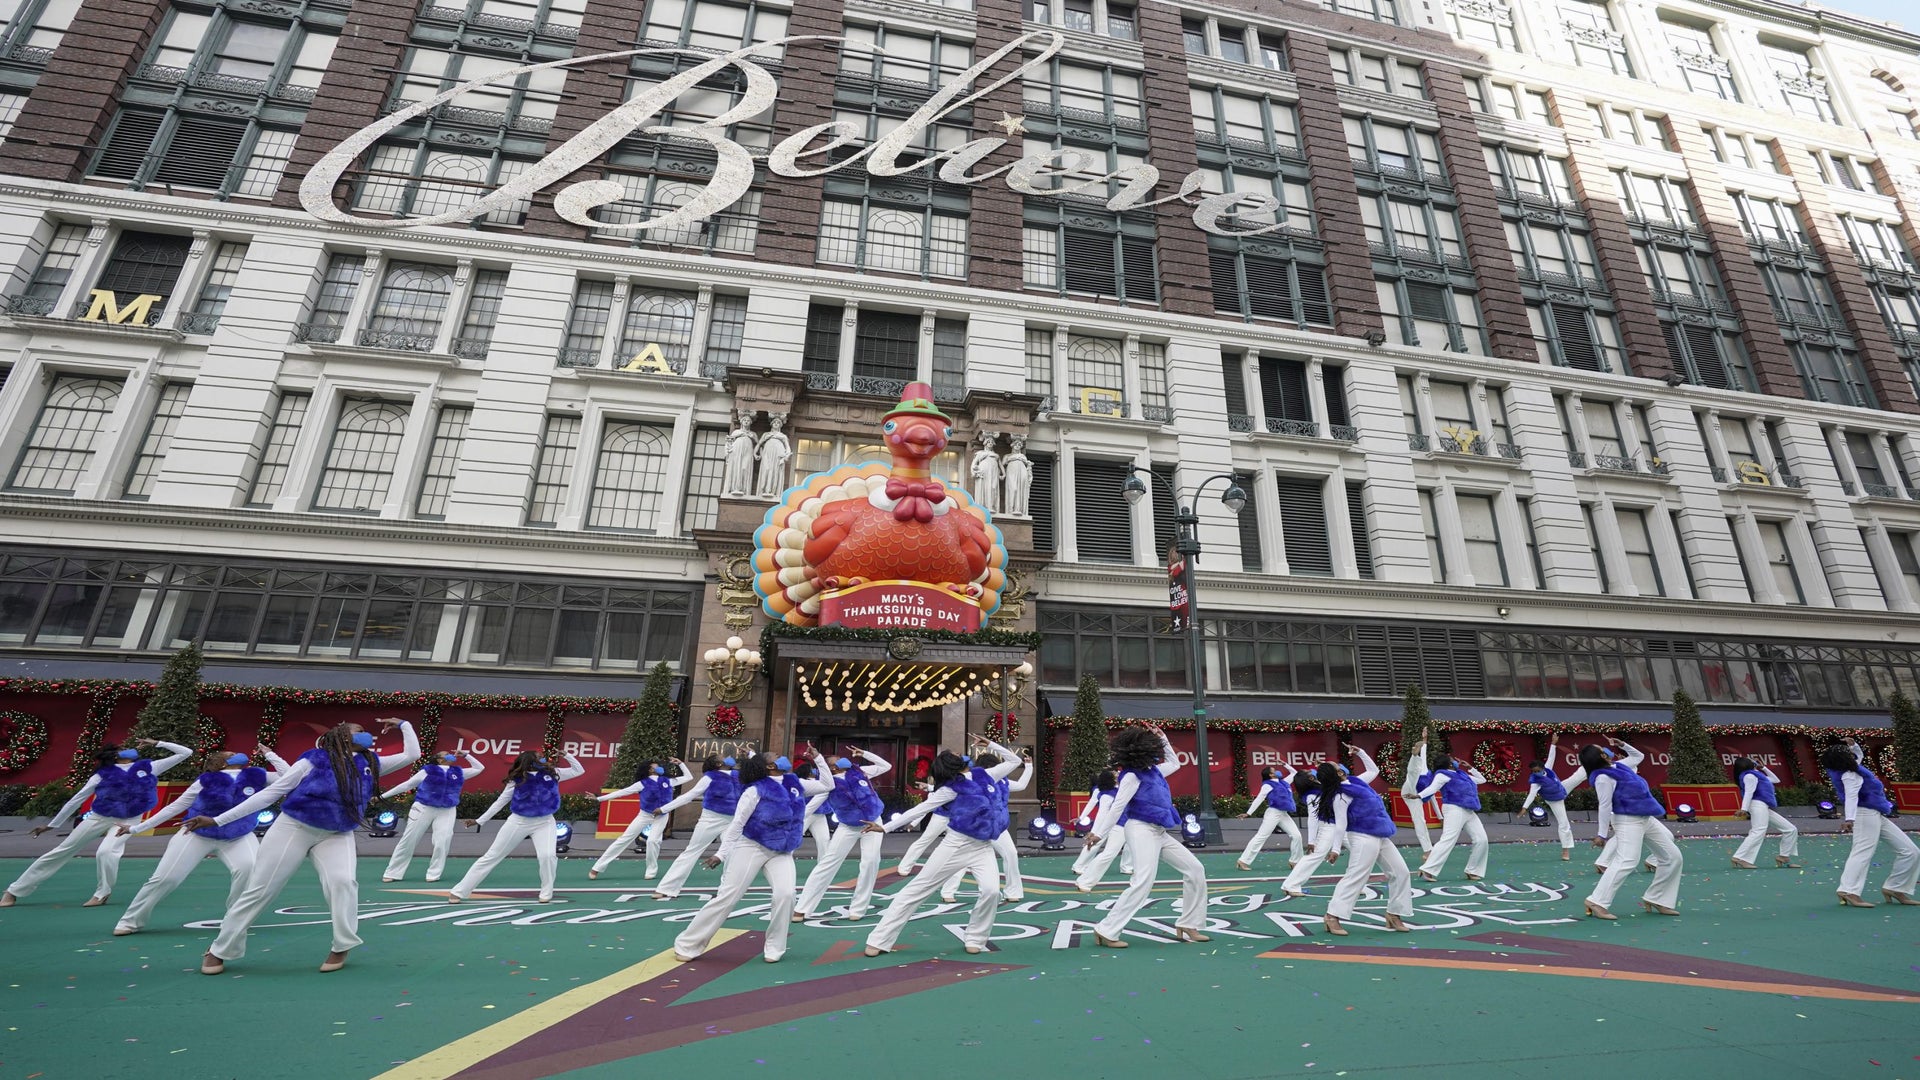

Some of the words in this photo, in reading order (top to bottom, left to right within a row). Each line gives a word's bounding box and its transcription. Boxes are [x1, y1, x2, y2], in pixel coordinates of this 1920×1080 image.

[299, 29, 1289, 236] Believe
[881, 593, 925, 605] MACY'S
[1171, 597, 1188, 608] BELIEV
[843, 605, 933, 618] THANKSGIVING
[938, 610, 960, 622] DAY
[877, 616, 928, 627] PARADE
[563, 741, 622, 758] BELI
[1176, 751, 1219, 766] OVE.
